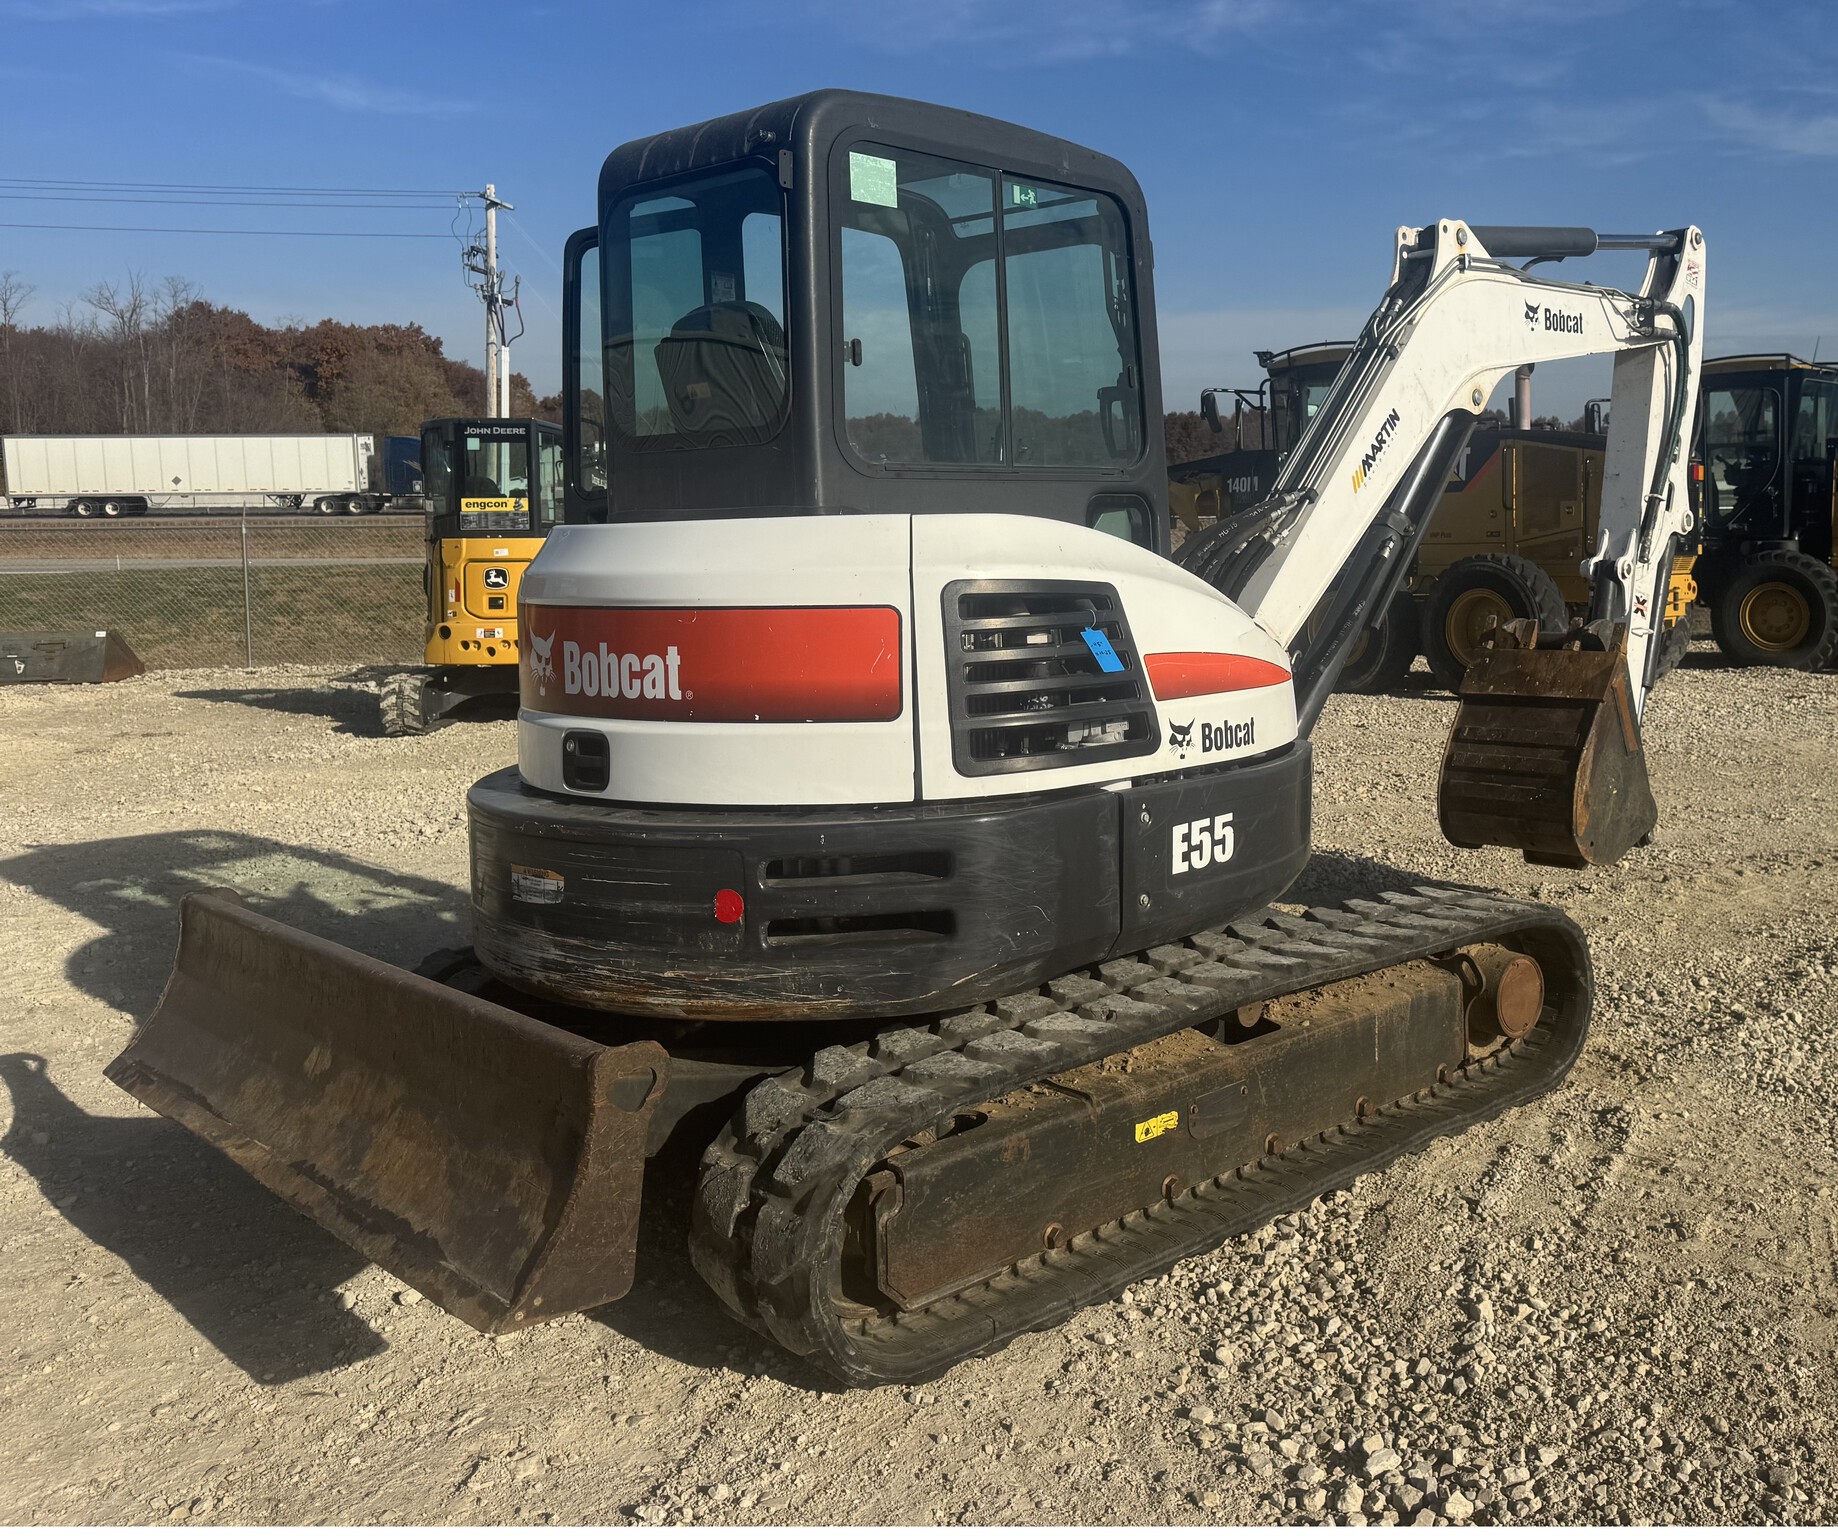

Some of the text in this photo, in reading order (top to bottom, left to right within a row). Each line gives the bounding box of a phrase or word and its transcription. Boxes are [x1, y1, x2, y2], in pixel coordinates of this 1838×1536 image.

[1544, 308, 1583, 334] Bobcat
[464, 426, 526, 435] JOHN DEERE
[1362, 408, 1400, 477] MARTIN
[465, 501, 508, 509] engcon
[563, 640, 682, 700] Bobcat
[1201, 717, 1255, 753] Bobcat
[1172, 812, 1235, 875] E55
